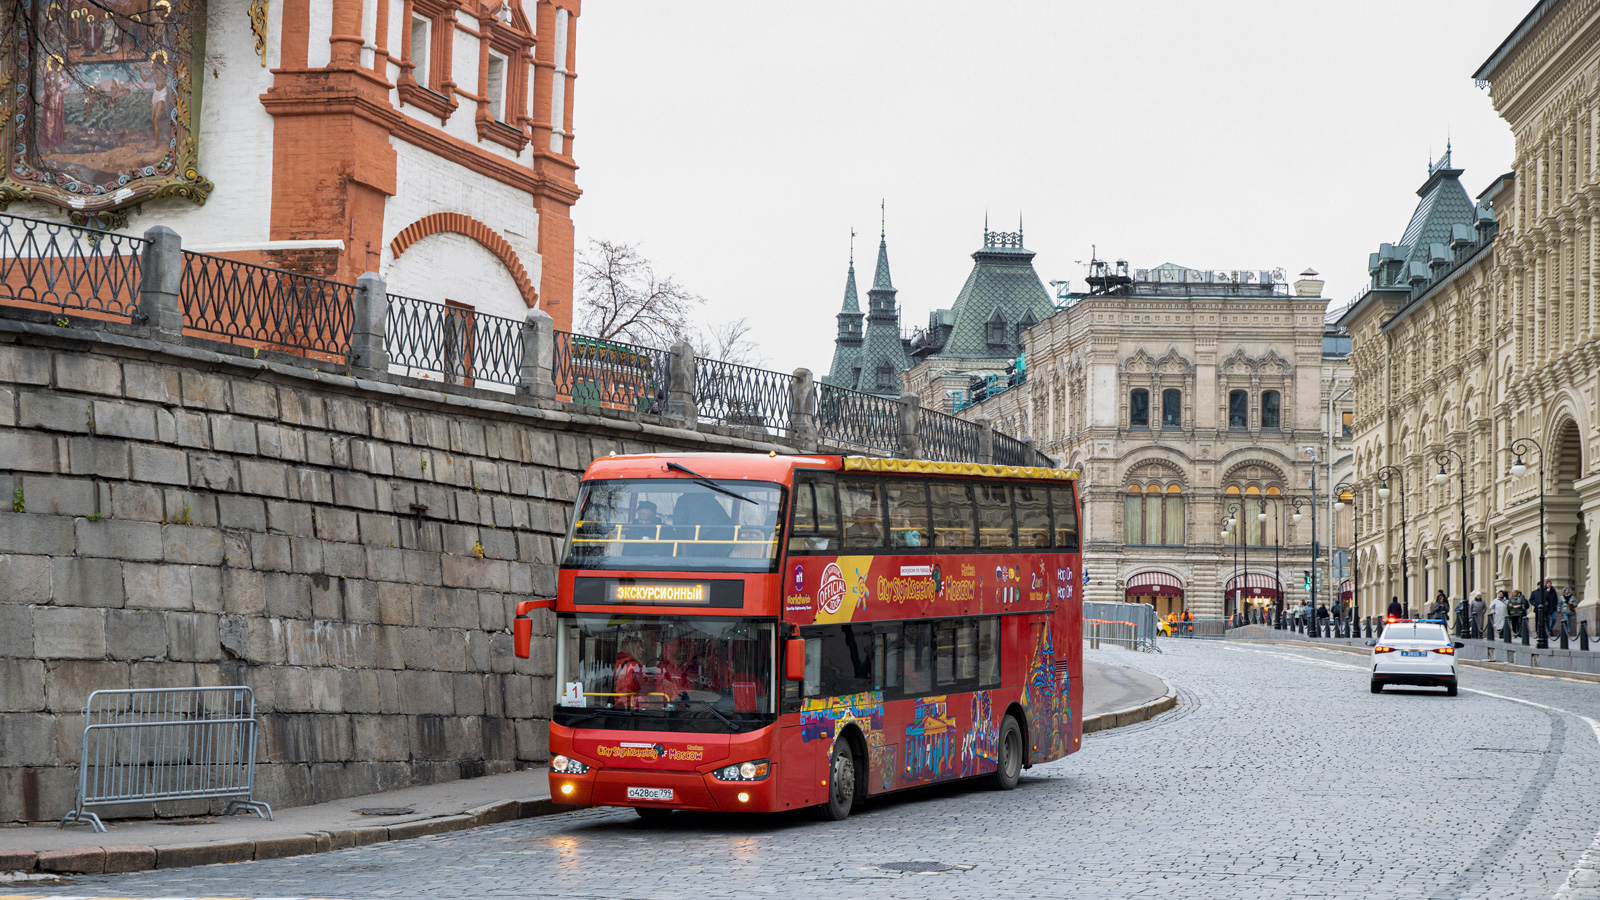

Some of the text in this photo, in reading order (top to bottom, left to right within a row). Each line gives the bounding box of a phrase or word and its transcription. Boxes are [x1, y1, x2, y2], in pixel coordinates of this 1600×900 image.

[1032, 572, 1036, 590] 2
[1057, 566, 1072, 582] Hop On
[617, 584, 703, 600] ЭКСКУРСИОННЫЙ
[820, 580, 846, 606] OFFICIAL
[877, 575, 936, 604] City Sightseeing
[1057, 586, 1066, 600] Hop
[830, 596, 841, 610] TOUR
[572, 686, 578, 699] 1
[597, 745, 658, 760] City Sightseeing
